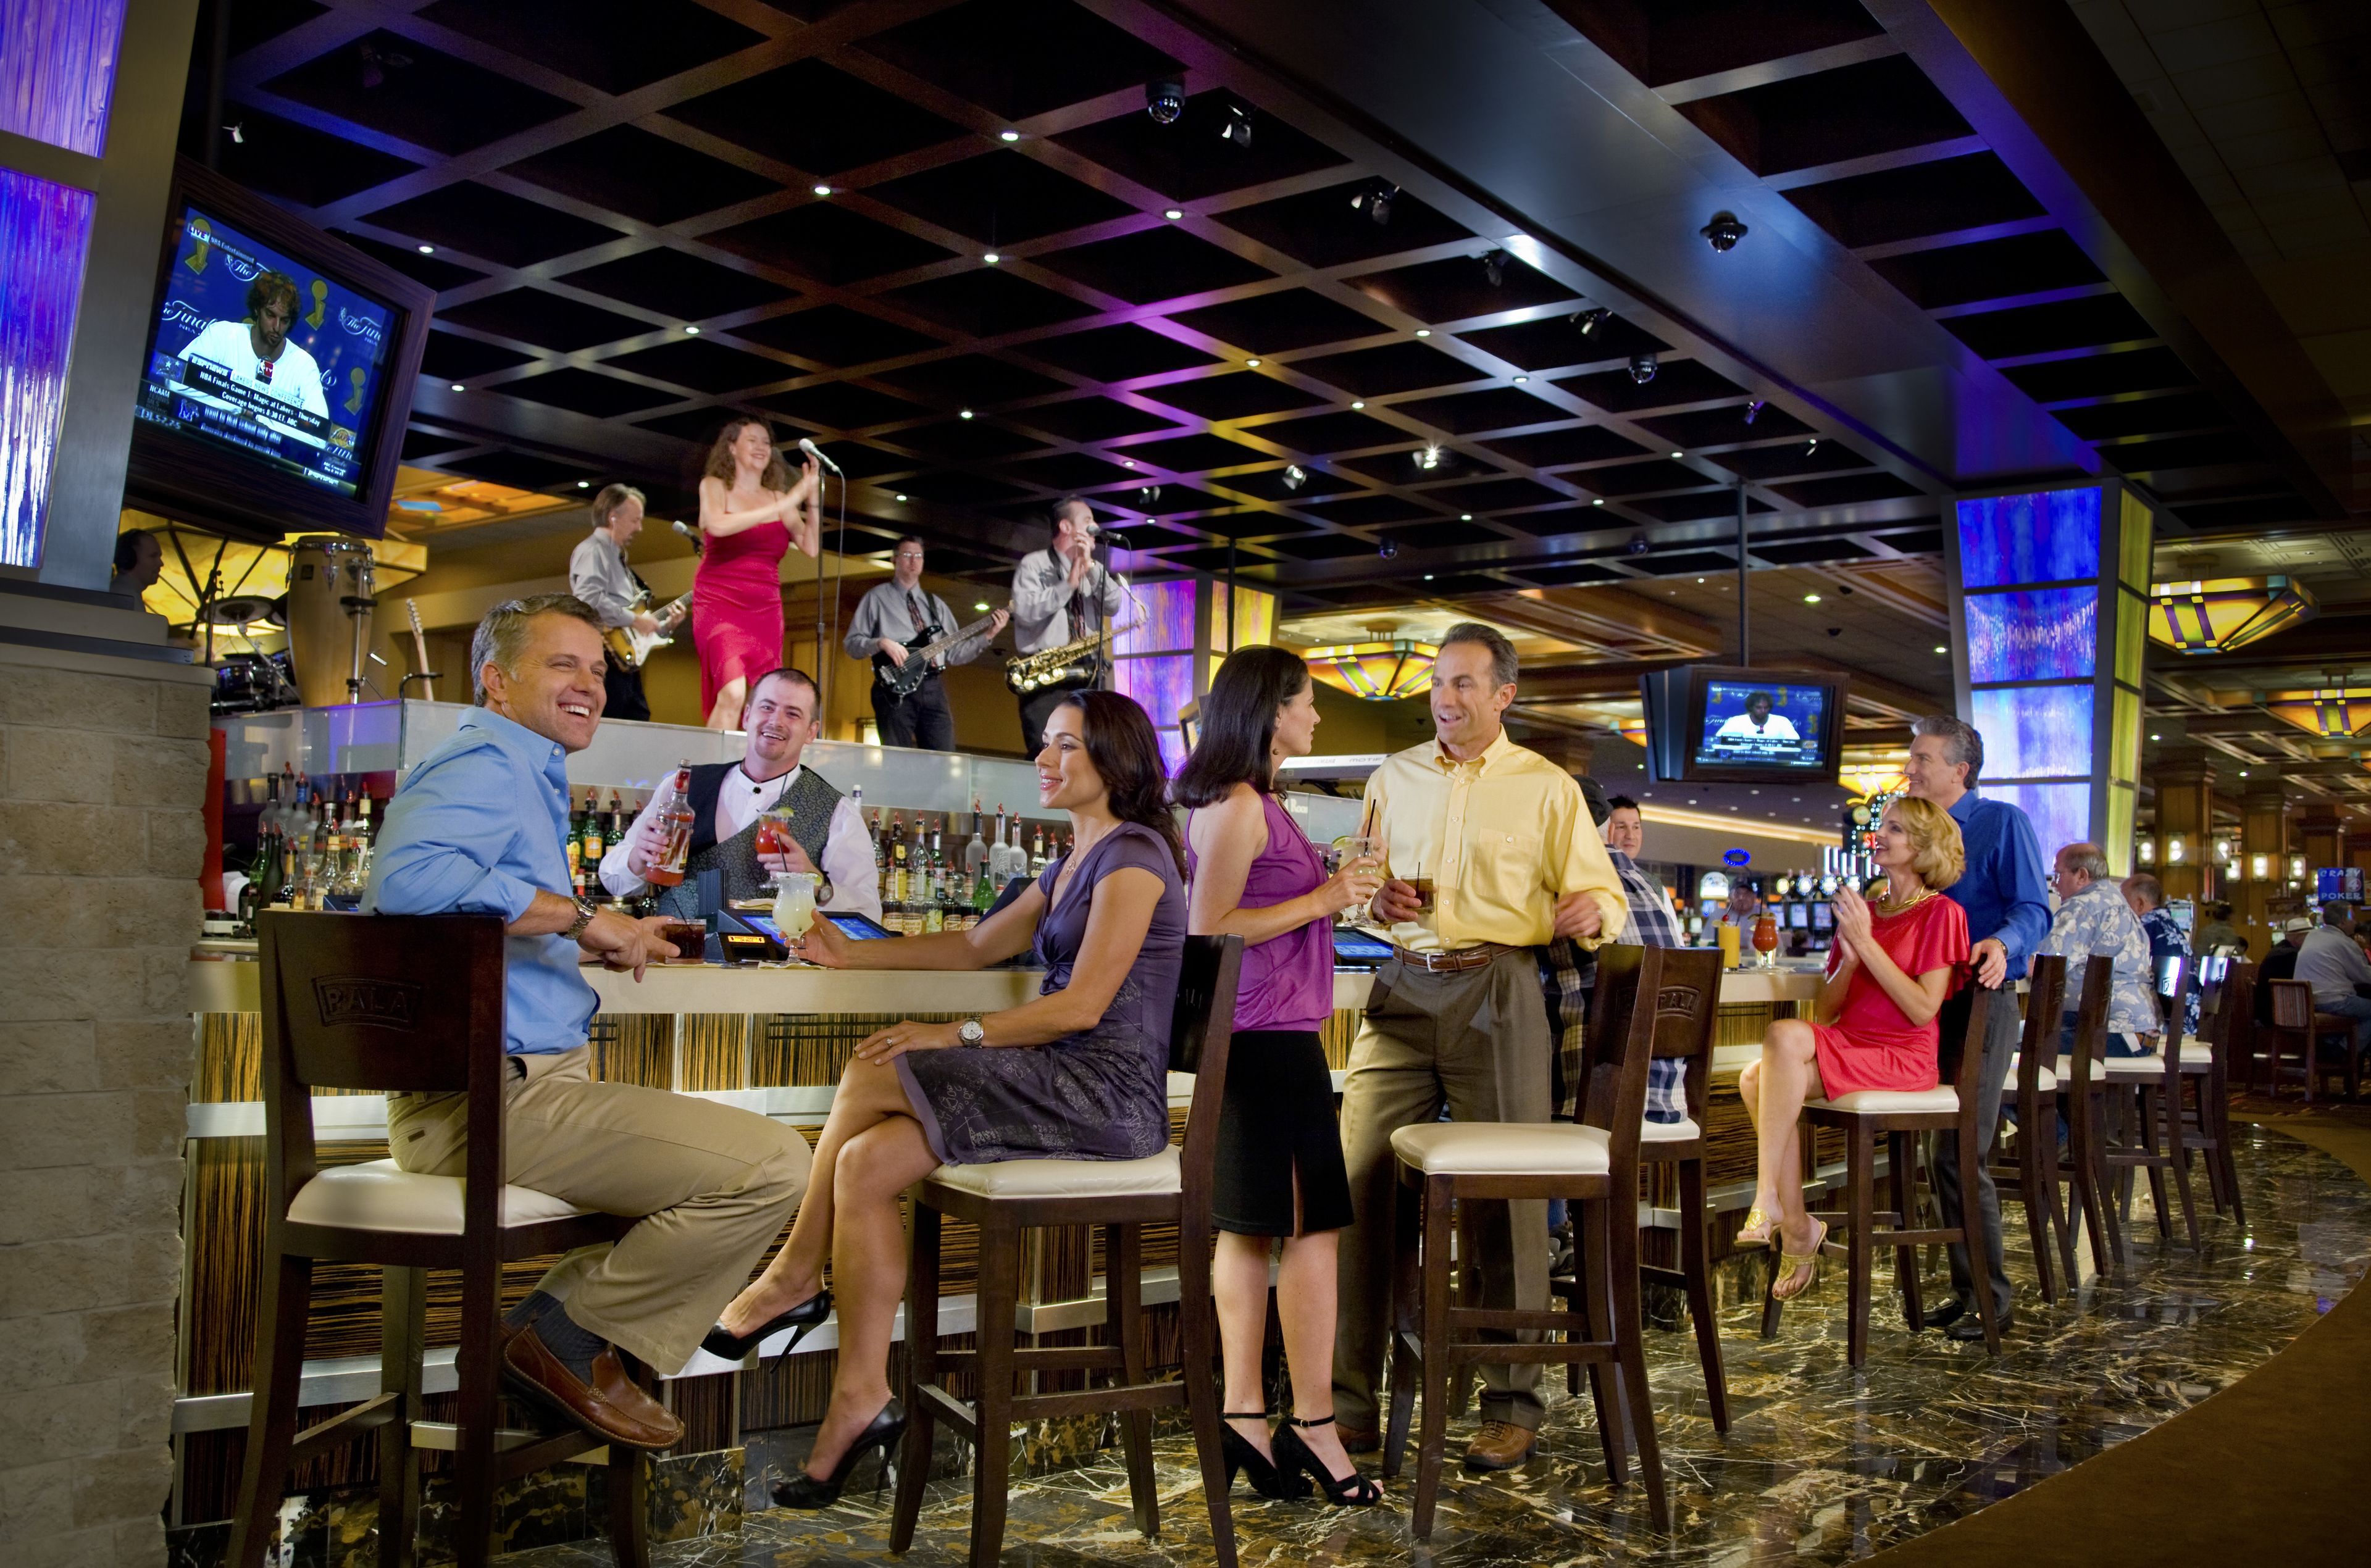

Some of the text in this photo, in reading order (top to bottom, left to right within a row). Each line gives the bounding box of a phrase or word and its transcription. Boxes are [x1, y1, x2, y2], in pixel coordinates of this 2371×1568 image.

[149, 385, 170, 398] NCAAM
[199, 371, 212, 383] NBA
[212, 377, 230, 390] Finals
[230, 384, 247, 396] Game
[253, 393, 270, 405] Magic
[270, 401, 276, 410] at
[276, 402, 294, 415] Lakers
[298, 412, 320, 427] Thursday
[232, 373, 304, 409] LAKERS NEWS CONFERENCE
[222, 391, 247, 408] Coverage
[247, 402, 266, 414] begins
[286, 417, 298, 427] ABC
[2320, 868, 2361, 877] CRAZY
[2348, 879, 2359, 890] 4
[2321, 892, 2362, 900] POKER
[326, 986, 409, 1016] PALA
[1658, 991, 1694, 1012] PALA
